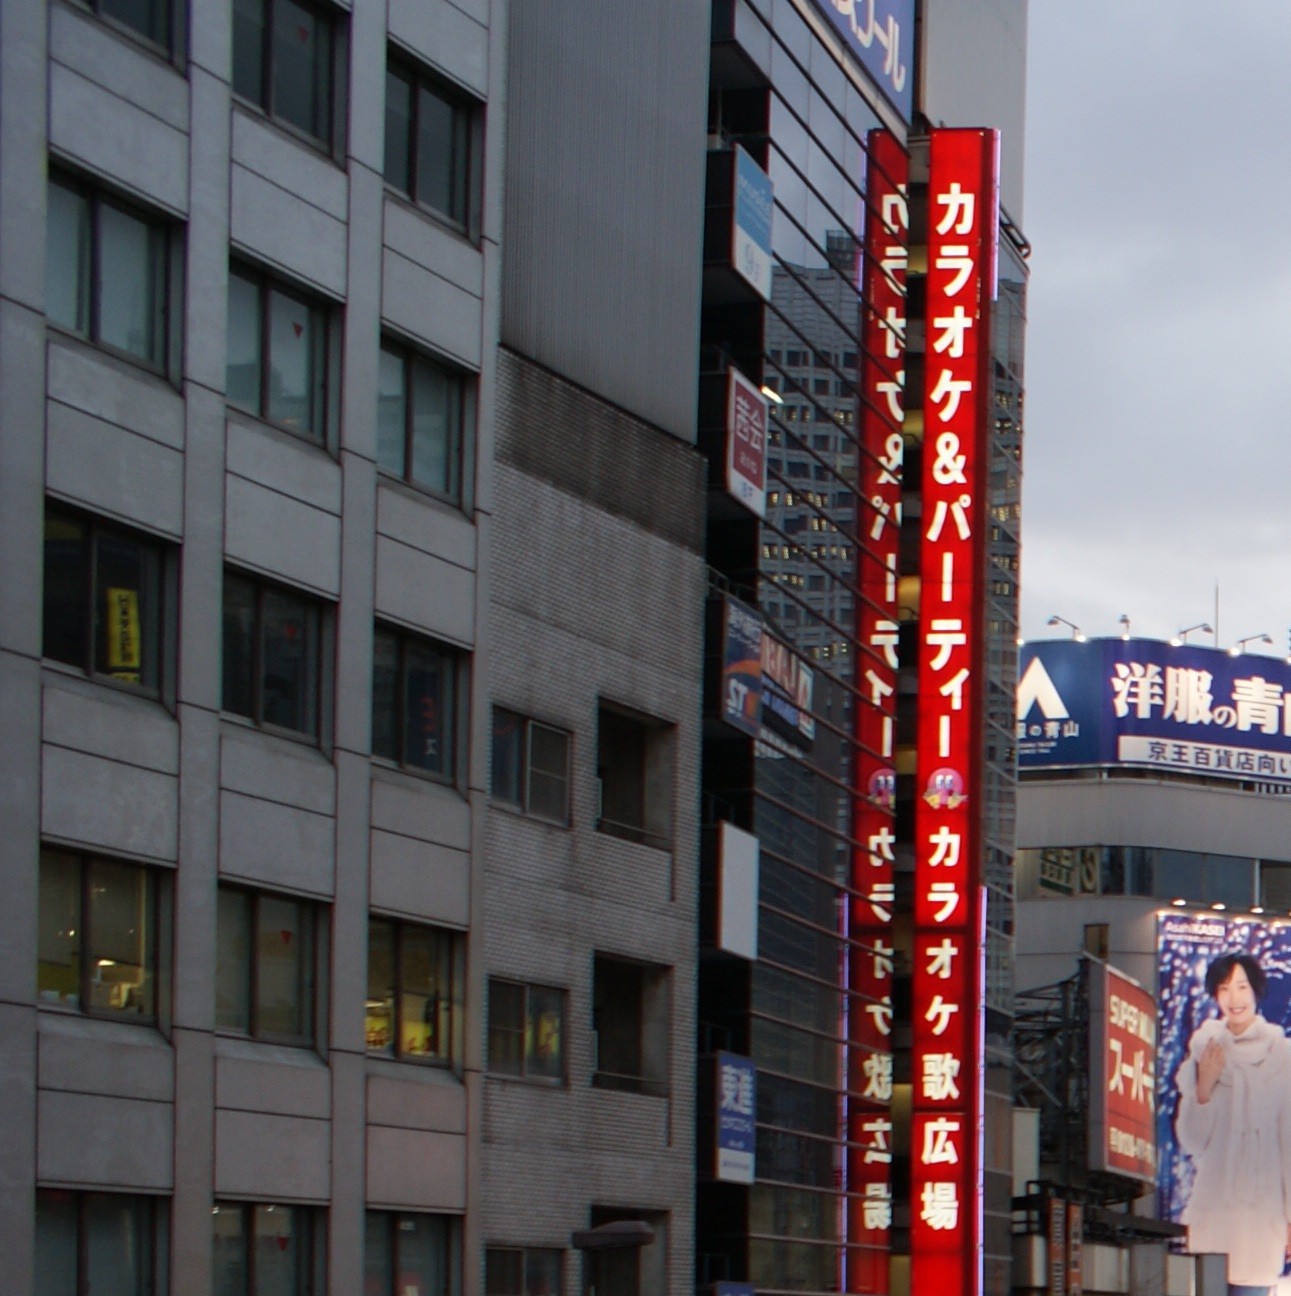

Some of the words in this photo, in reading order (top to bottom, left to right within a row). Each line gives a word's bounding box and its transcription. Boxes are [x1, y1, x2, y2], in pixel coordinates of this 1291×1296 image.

[925, 183, 975, 757] カラオケ&パーティー
[920, 826, 962, 1231] カラオケ歌広場
